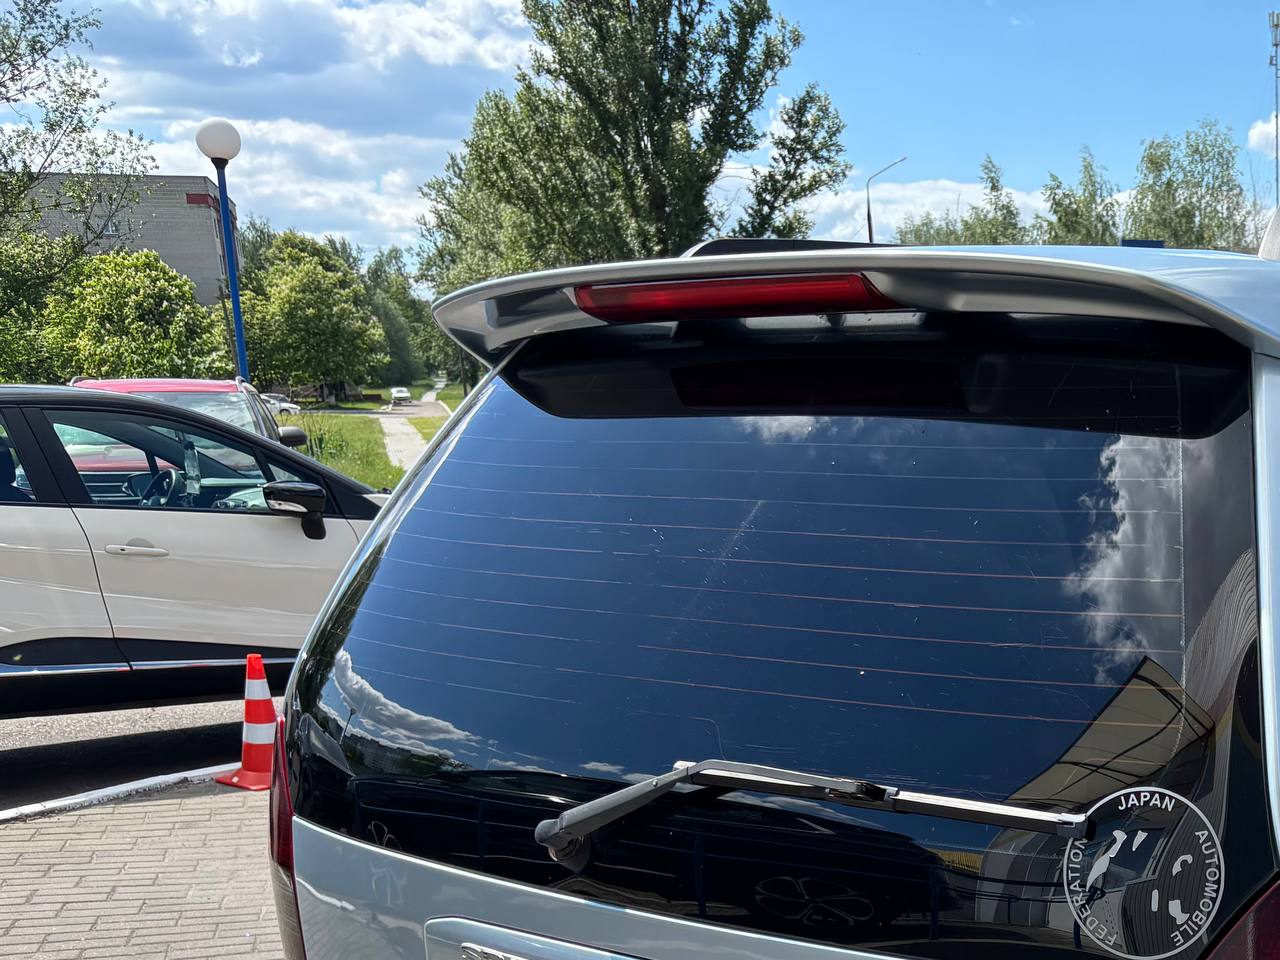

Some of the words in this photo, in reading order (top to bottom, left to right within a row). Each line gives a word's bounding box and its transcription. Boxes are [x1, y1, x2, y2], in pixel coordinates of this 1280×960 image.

[1118, 791, 1176, 812] JAPAN
[1068, 837, 1118, 946] FEDERATION
[1170, 829, 1220, 947] AUTOMOBILE
